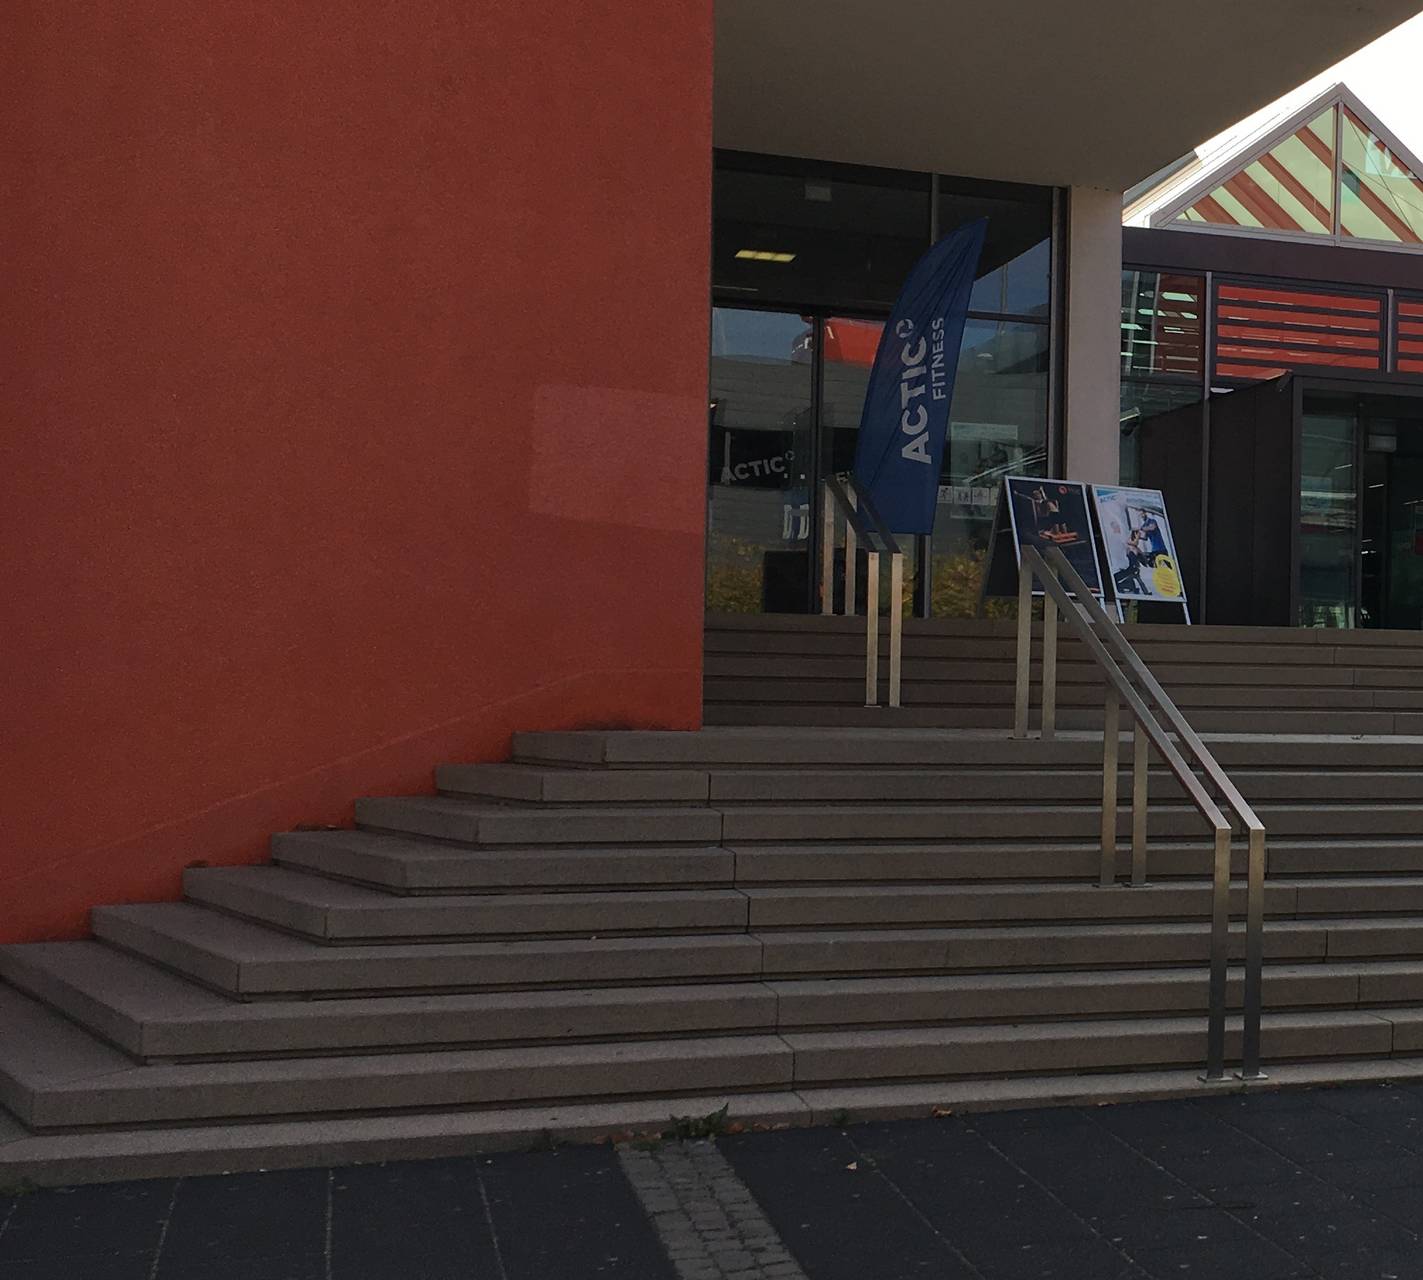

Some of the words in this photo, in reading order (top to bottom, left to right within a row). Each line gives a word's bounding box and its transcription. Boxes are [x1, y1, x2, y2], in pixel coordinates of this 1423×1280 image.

[901, 336, 932, 464] ACTIC
[932, 318, 946, 400] FITNESS
[721, 457, 785, 482] ACTIC
